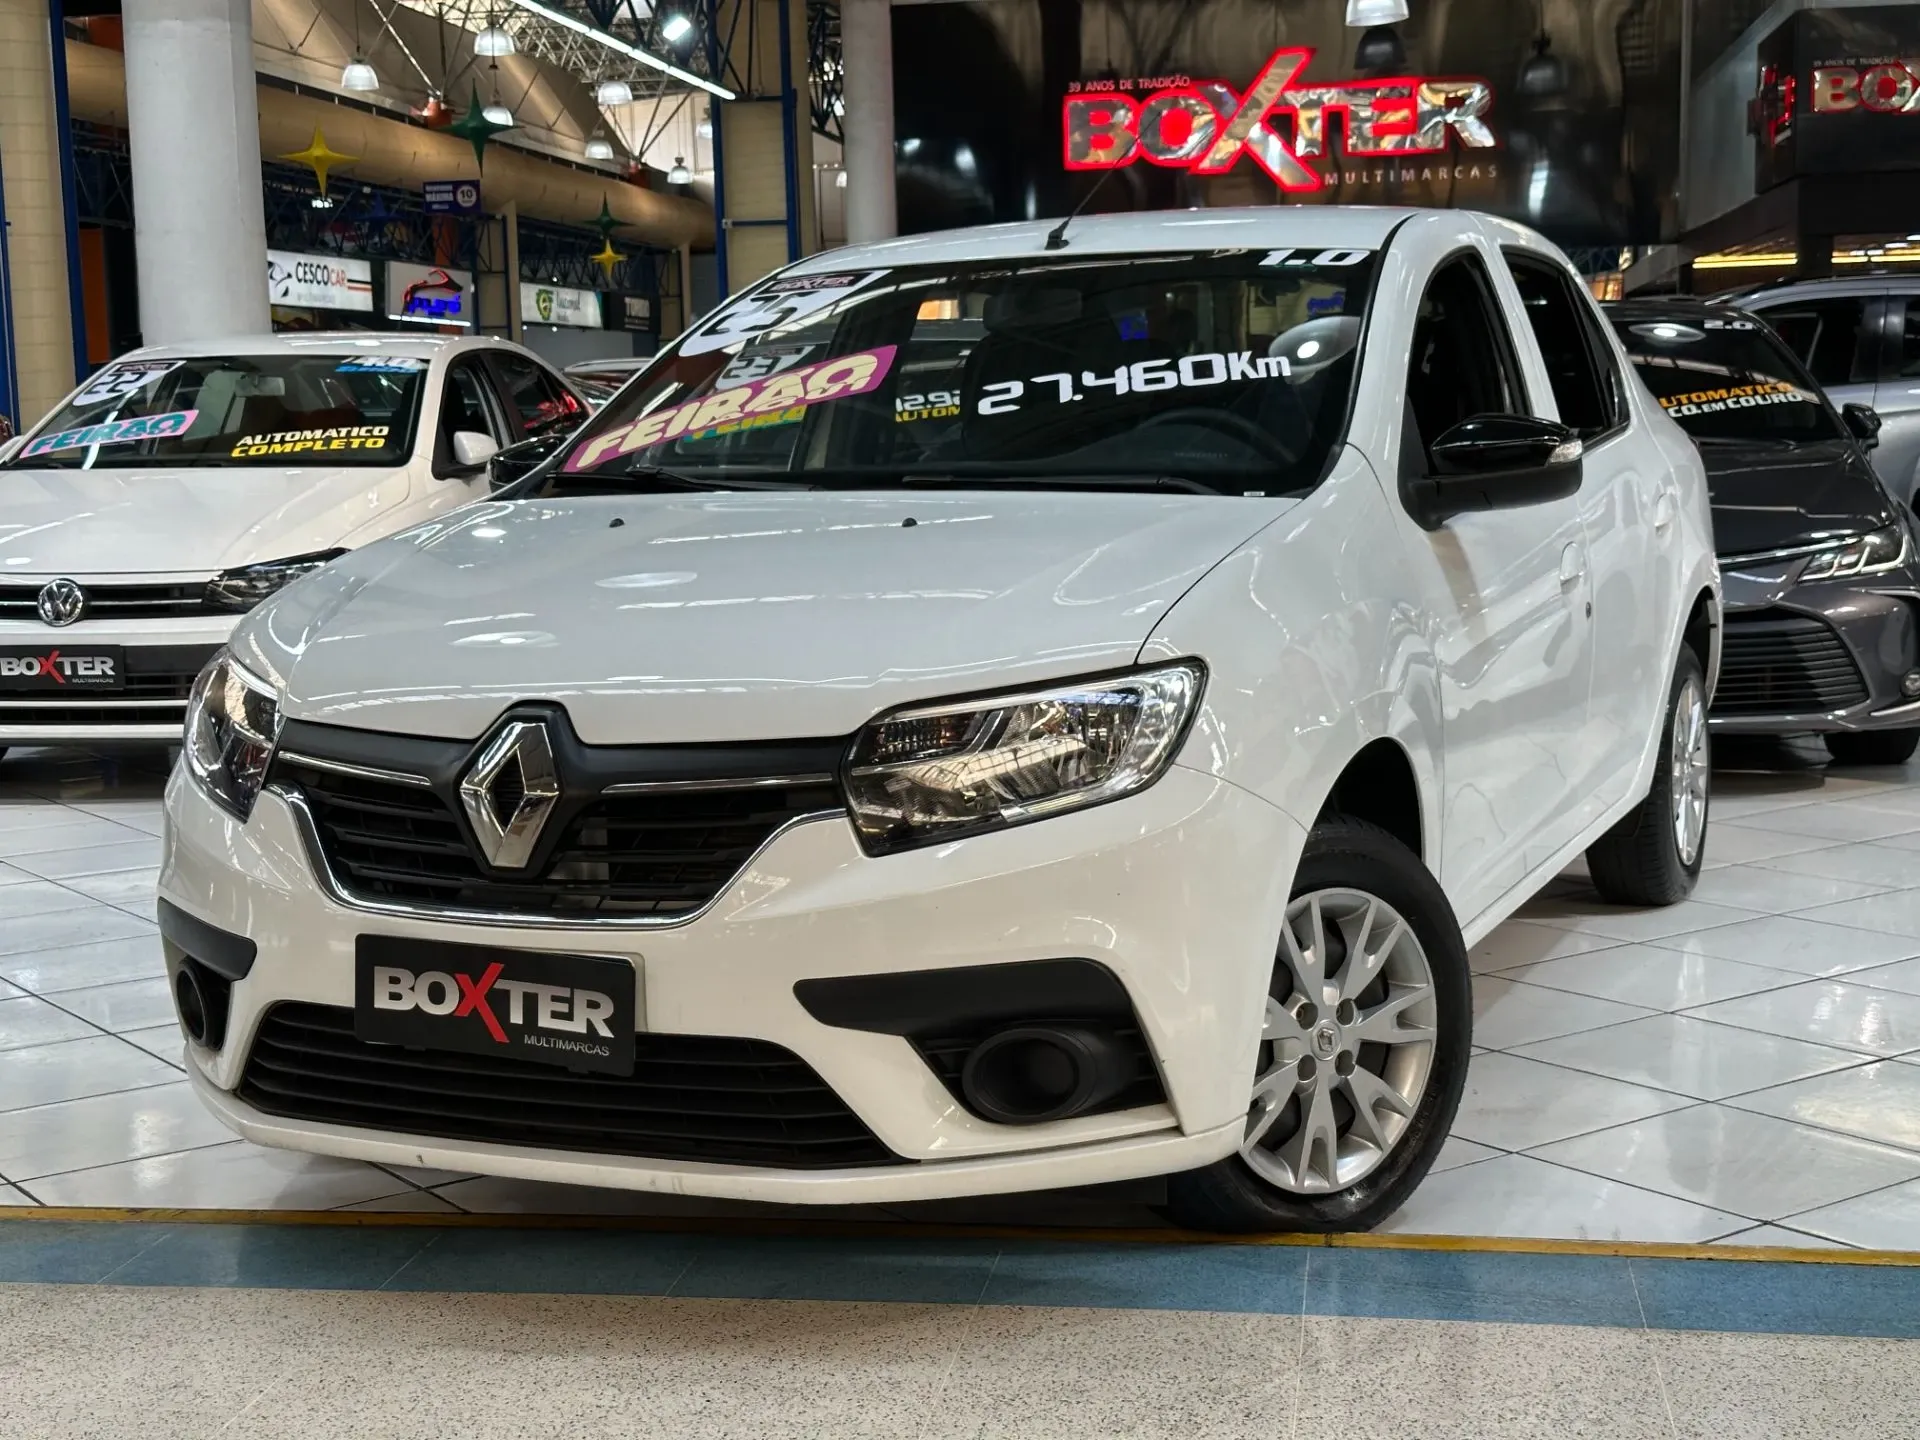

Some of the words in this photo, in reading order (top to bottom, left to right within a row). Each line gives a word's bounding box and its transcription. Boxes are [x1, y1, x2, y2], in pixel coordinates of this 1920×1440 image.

[1068, 81, 1081, 92] 39
[1085, 79, 1115, 91] ANOS
[1119, 79, 1133, 90] DE
[1139, 74, 1190, 89] TRADIÇÃO
[1811, 58, 1920, 115] BO
[1063, 46, 1497, 192] BOXTER
[1325, 164, 1498, 186] MULTIMARCAS
[1258, 248, 1371, 265] 1.0
[295, 262, 347, 288] CESCOCAR
[577, 354, 878, 468] FEIRÃO
[1701, 401, 1726, 413] EM
[1726, 392, 1803, 409] COURO
[231, 437, 386, 458] COMPLETO
[236, 426, 390, 447] AUTOMATICO
[0, 648, 116, 684] BOXTER
[373, 962, 615, 1043] BOXTER
[523, 1034, 610, 1057] MULTIMARCAS
